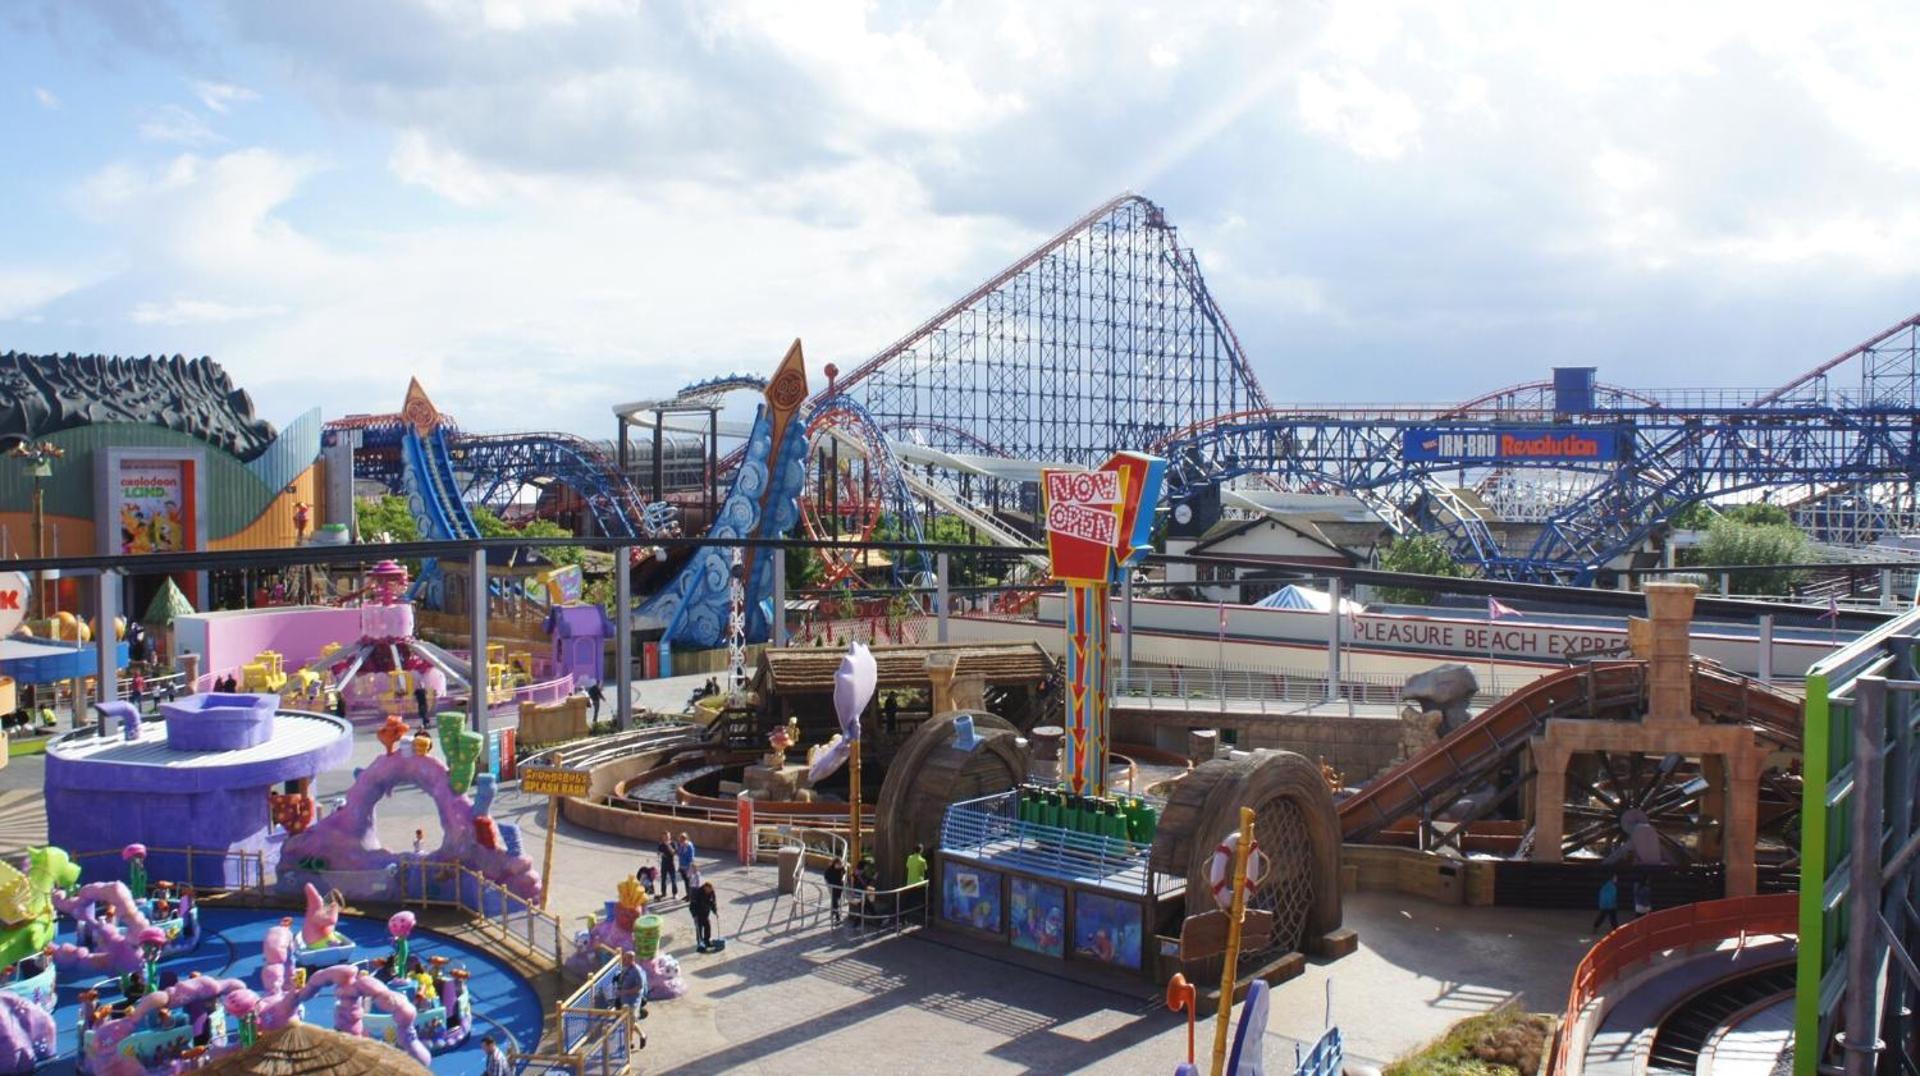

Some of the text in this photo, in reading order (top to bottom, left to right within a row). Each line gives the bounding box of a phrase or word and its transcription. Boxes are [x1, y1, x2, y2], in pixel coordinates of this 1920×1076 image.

[1438, 434, 1497, 458] IRN-BRU
[1501, 434, 1598, 457] Revolution
[1049, 473, 1117, 502] NOW
[1049, 503, 1117, 544] OPEN
[1353, 621, 1454, 647] PLEASURE
[1464, 629, 1537, 652] BEACH
